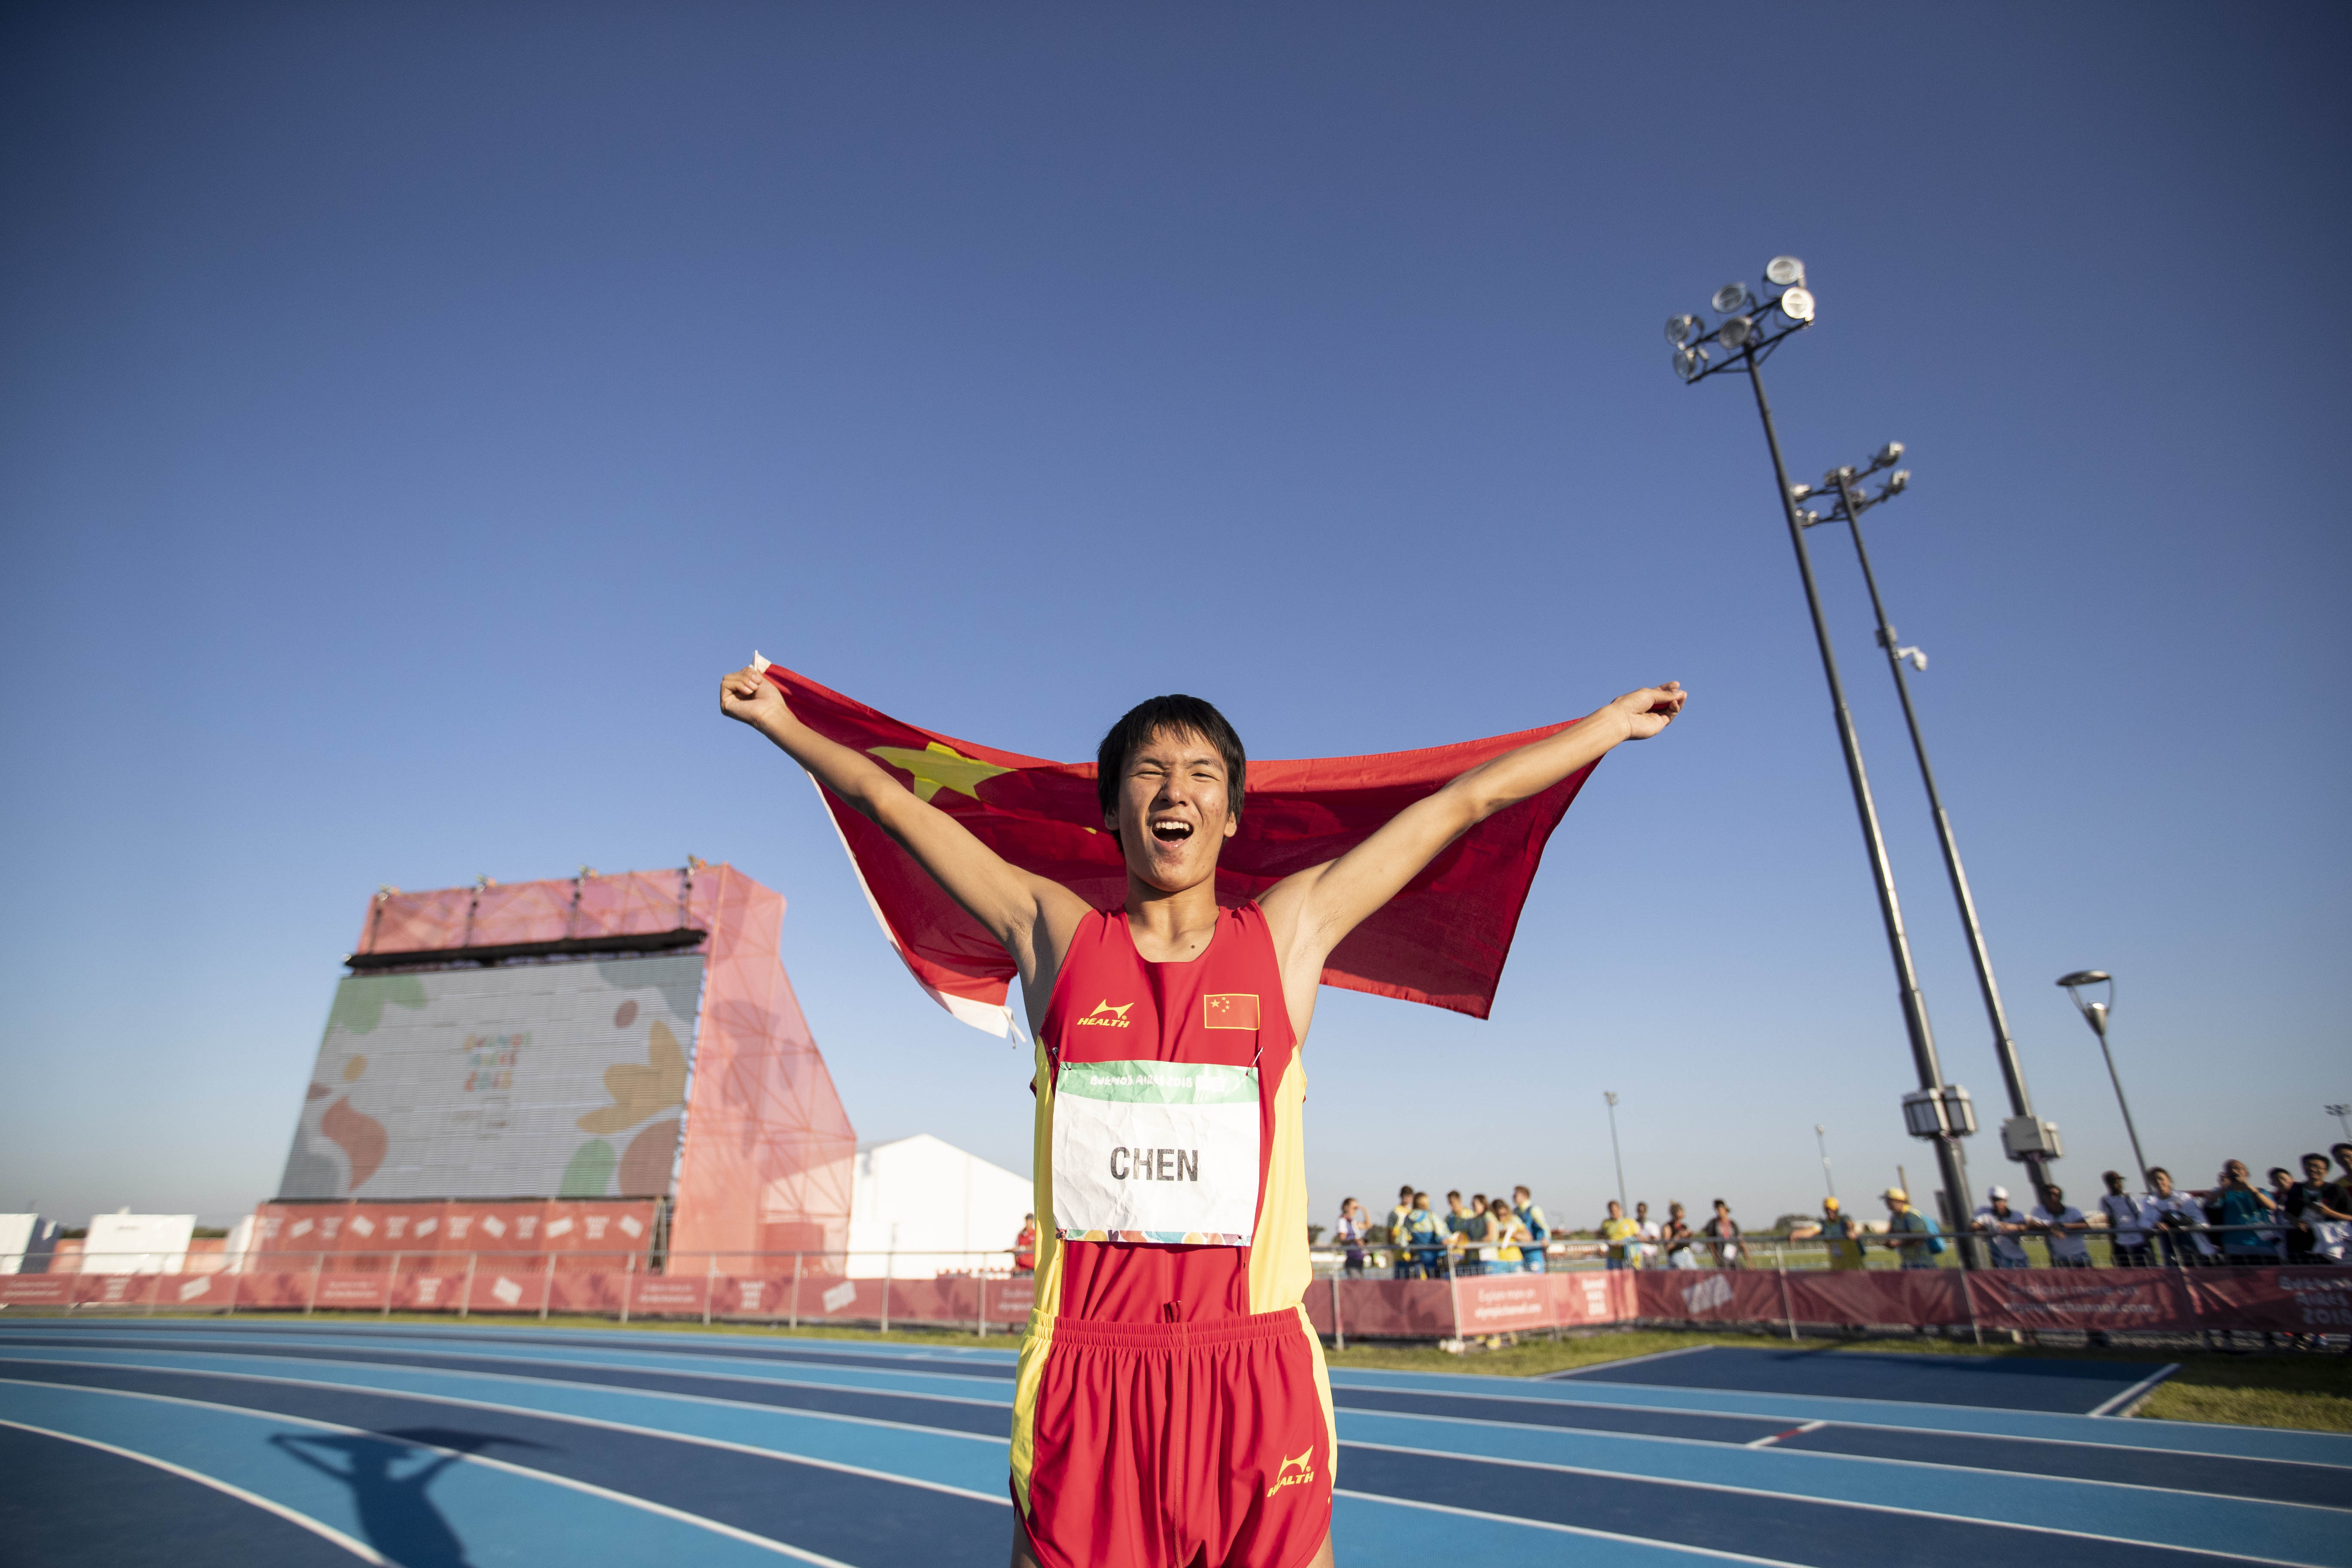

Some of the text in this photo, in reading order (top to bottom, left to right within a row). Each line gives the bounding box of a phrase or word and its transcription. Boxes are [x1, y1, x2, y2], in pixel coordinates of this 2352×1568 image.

[1077, 1017, 1130, 1028] HEALTH
[1167, 1076, 1193, 1088] 2018
[1110, 1146, 1198, 1182] CHEN
